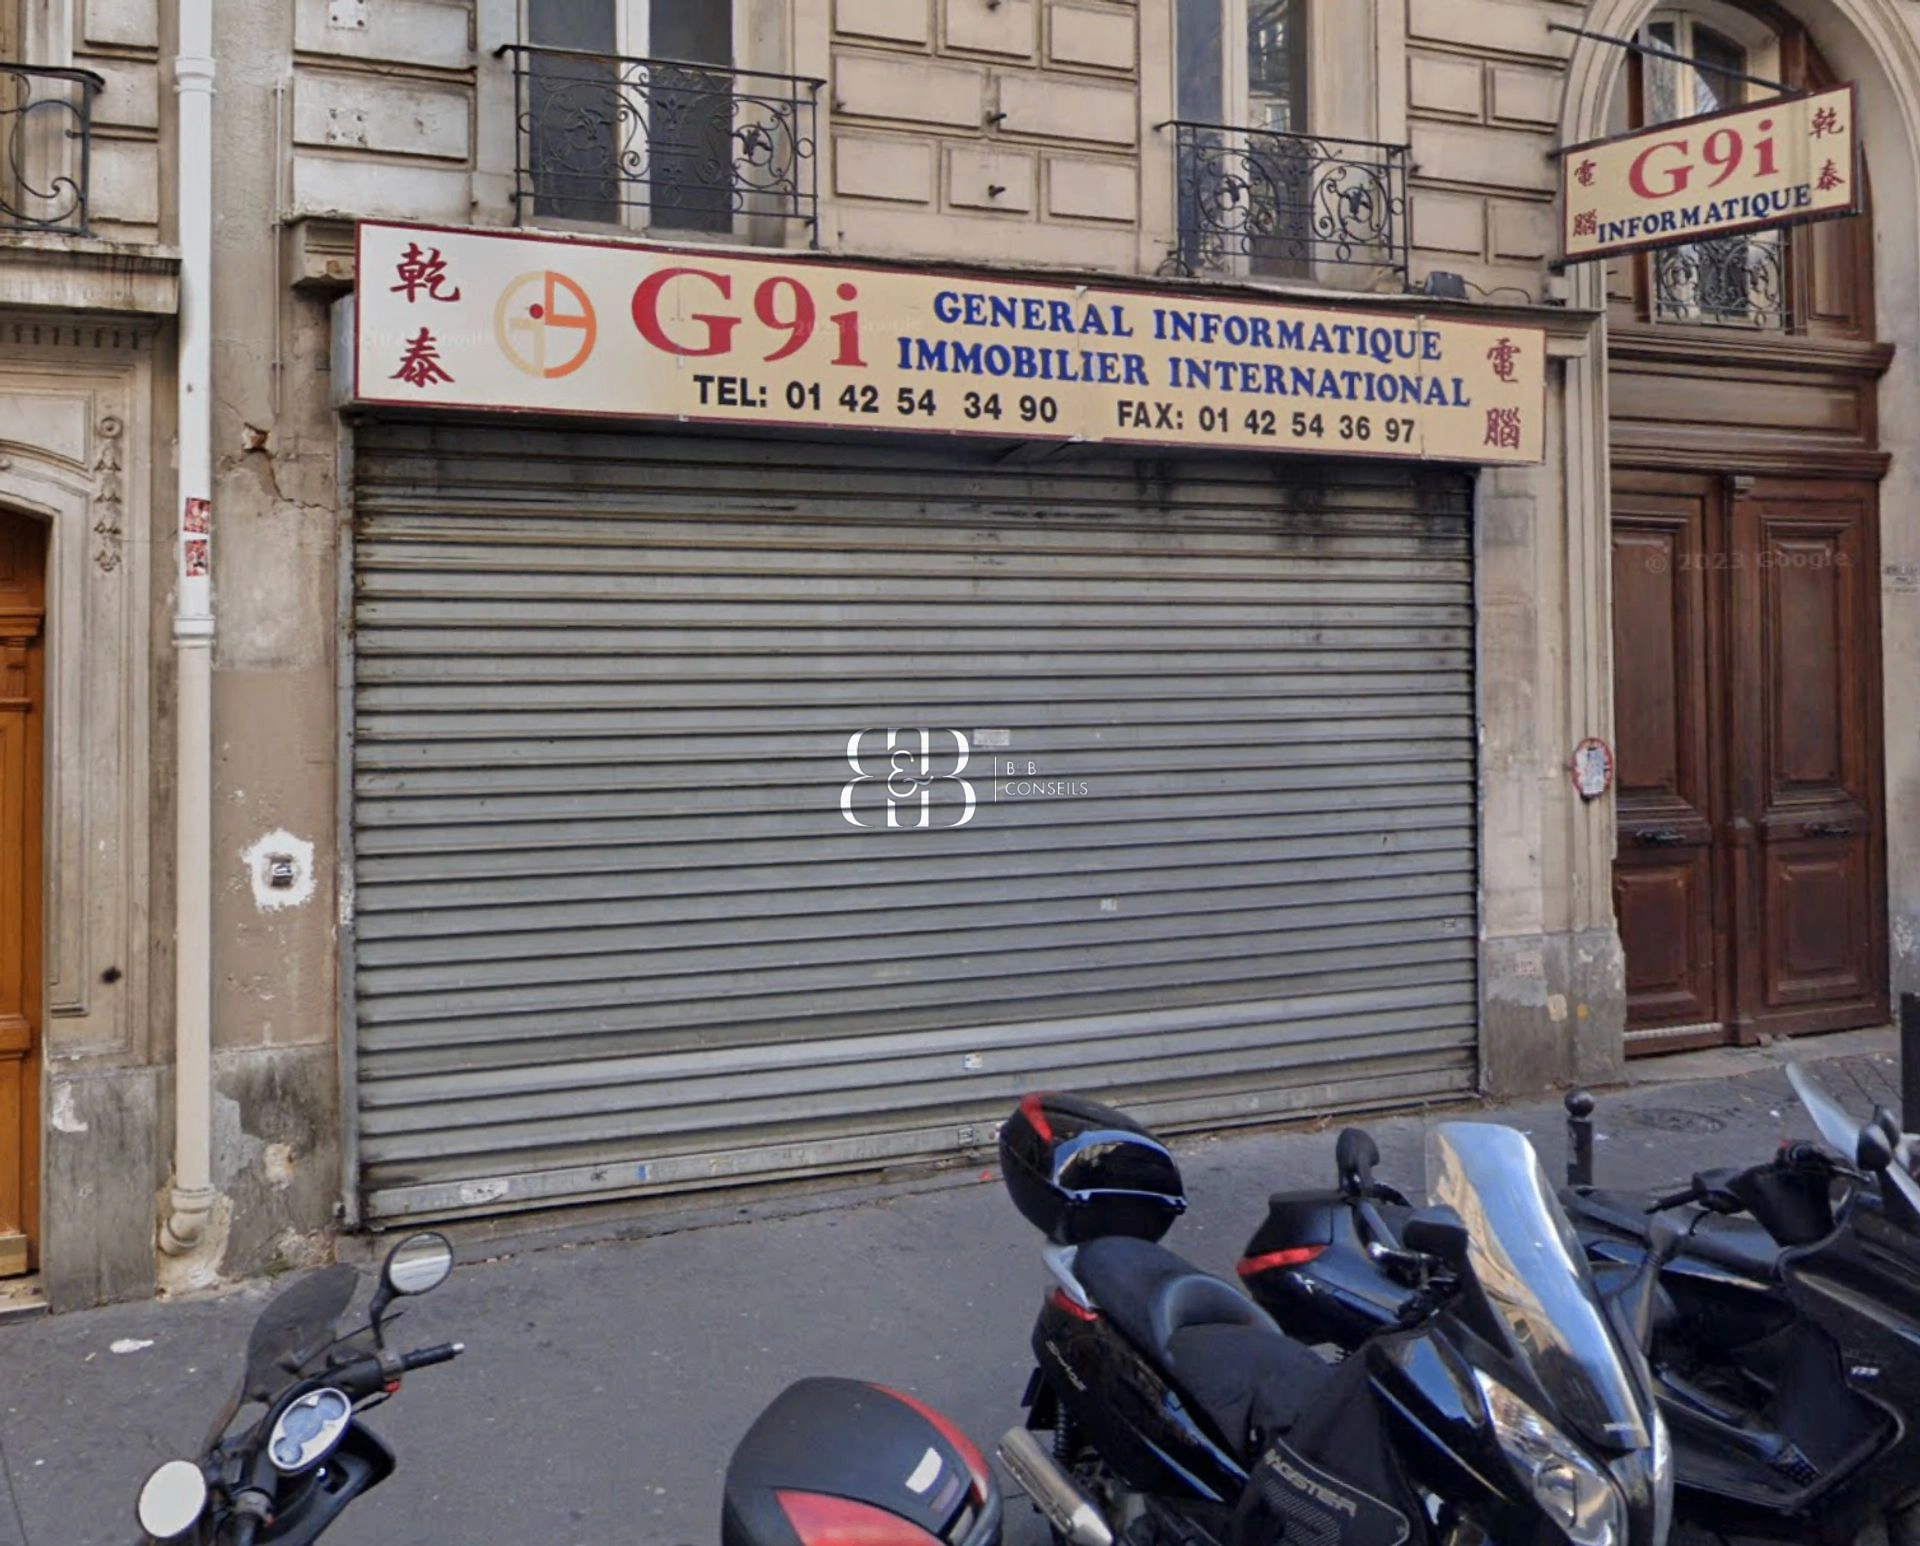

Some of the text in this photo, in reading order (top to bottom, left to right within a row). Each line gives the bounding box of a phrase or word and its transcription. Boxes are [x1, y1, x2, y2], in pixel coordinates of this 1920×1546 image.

[1628, 119, 1779, 200] G9i
[1598, 184, 1812, 243] INFORMATIQUE
[631, 267, 868, 367] G9i
[934, 291, 1133, 337] GENERAL
[1153, 309, 1442, 362] INFORMATIQUE
[693, 374, 1058, 424] TEL: 01 42 54 34 90
[896, 337, 1471, 407] IMMOBILIER INTERNATIONAL
[1117, 400, 1416, 444] FAX: 01 42 54 36 97
